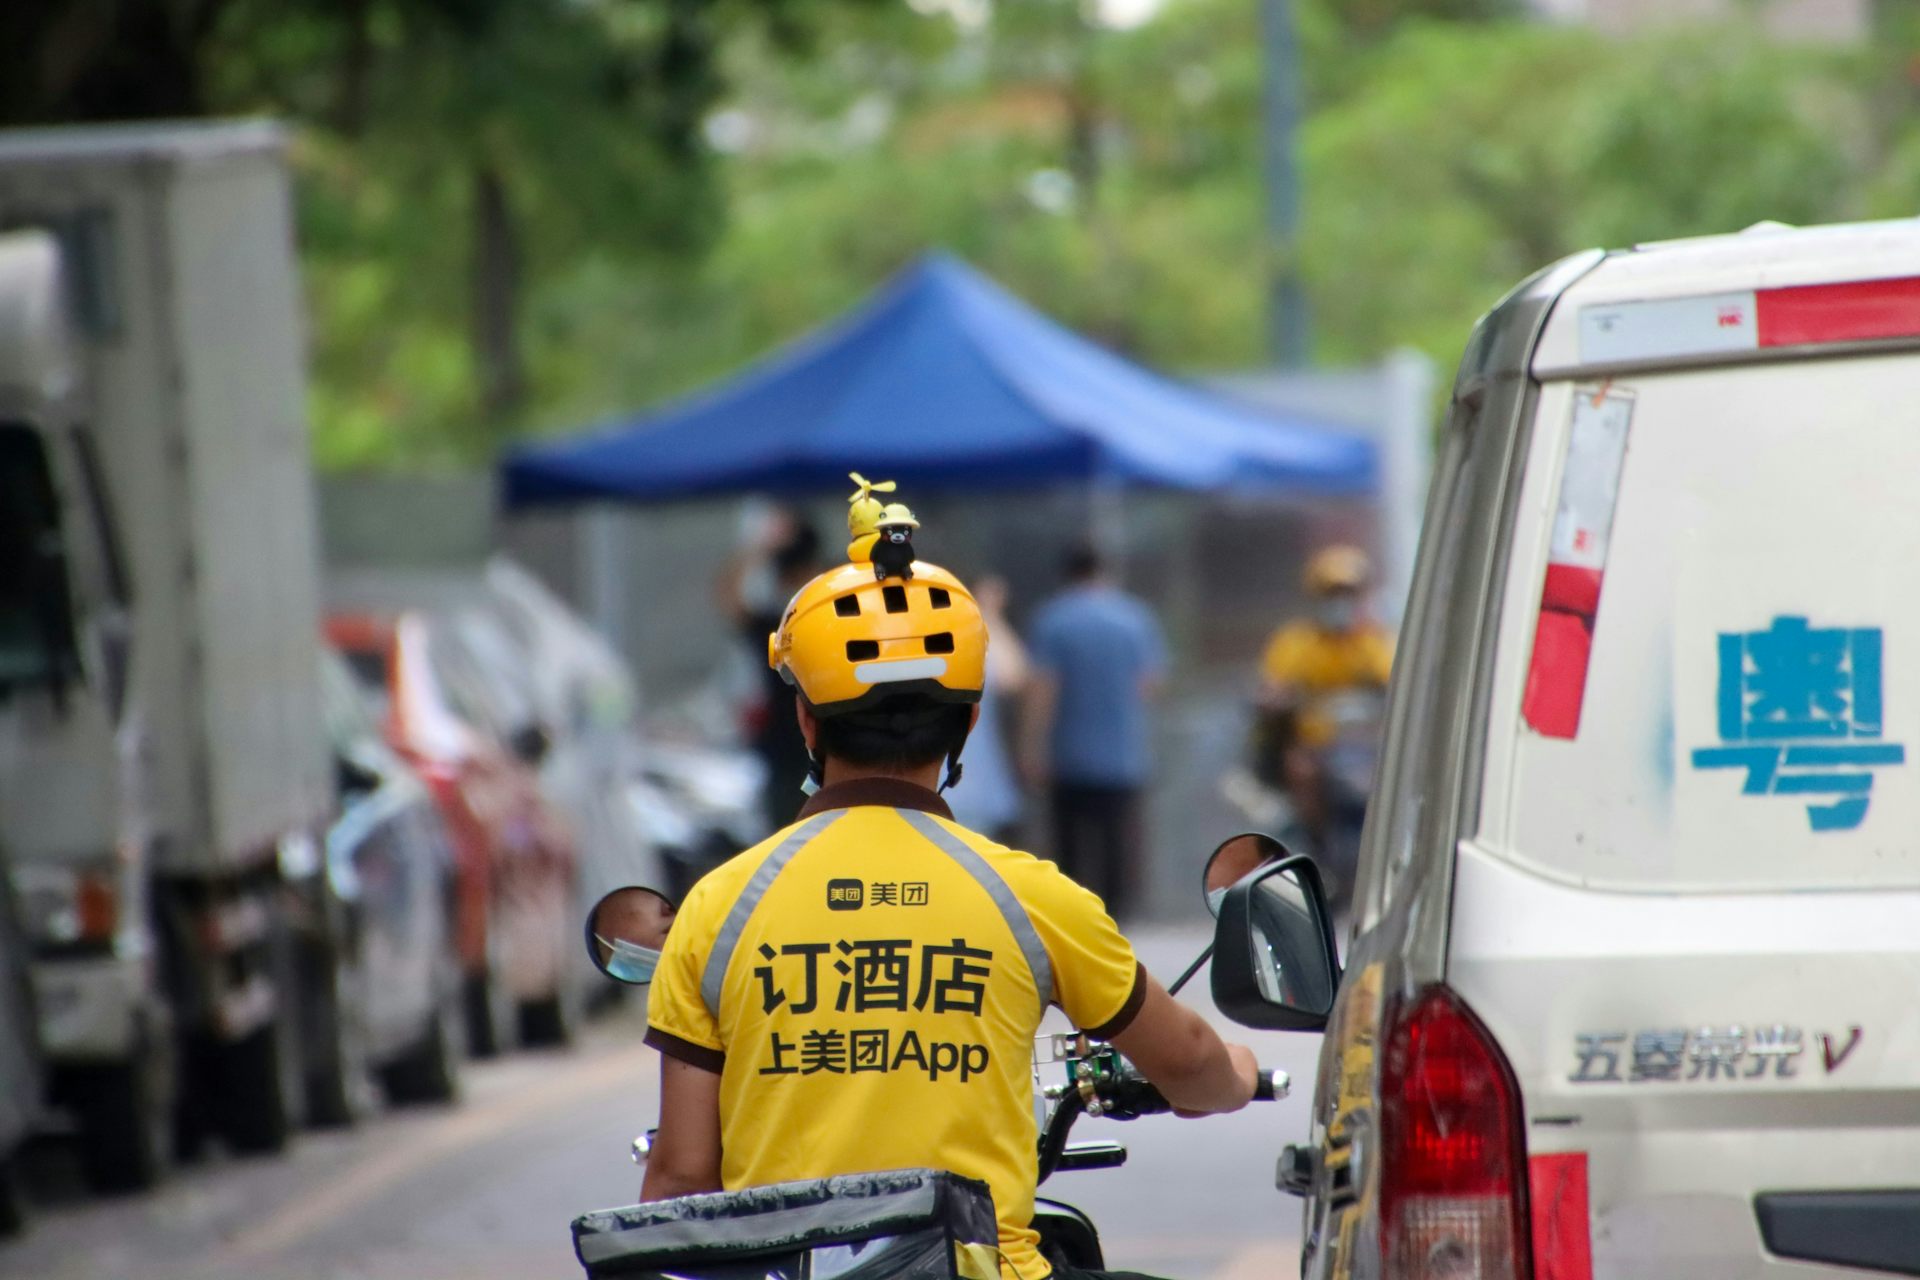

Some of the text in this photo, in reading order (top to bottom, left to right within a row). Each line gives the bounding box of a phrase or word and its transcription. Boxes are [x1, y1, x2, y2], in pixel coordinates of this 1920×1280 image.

[1691, 615, 1905, 832] 粤
[830, 882, 929, 906] 美团 美团
[754, 938, 993, 1017] 订酒店
[758, 1029, 990, 1083] 上美团App
